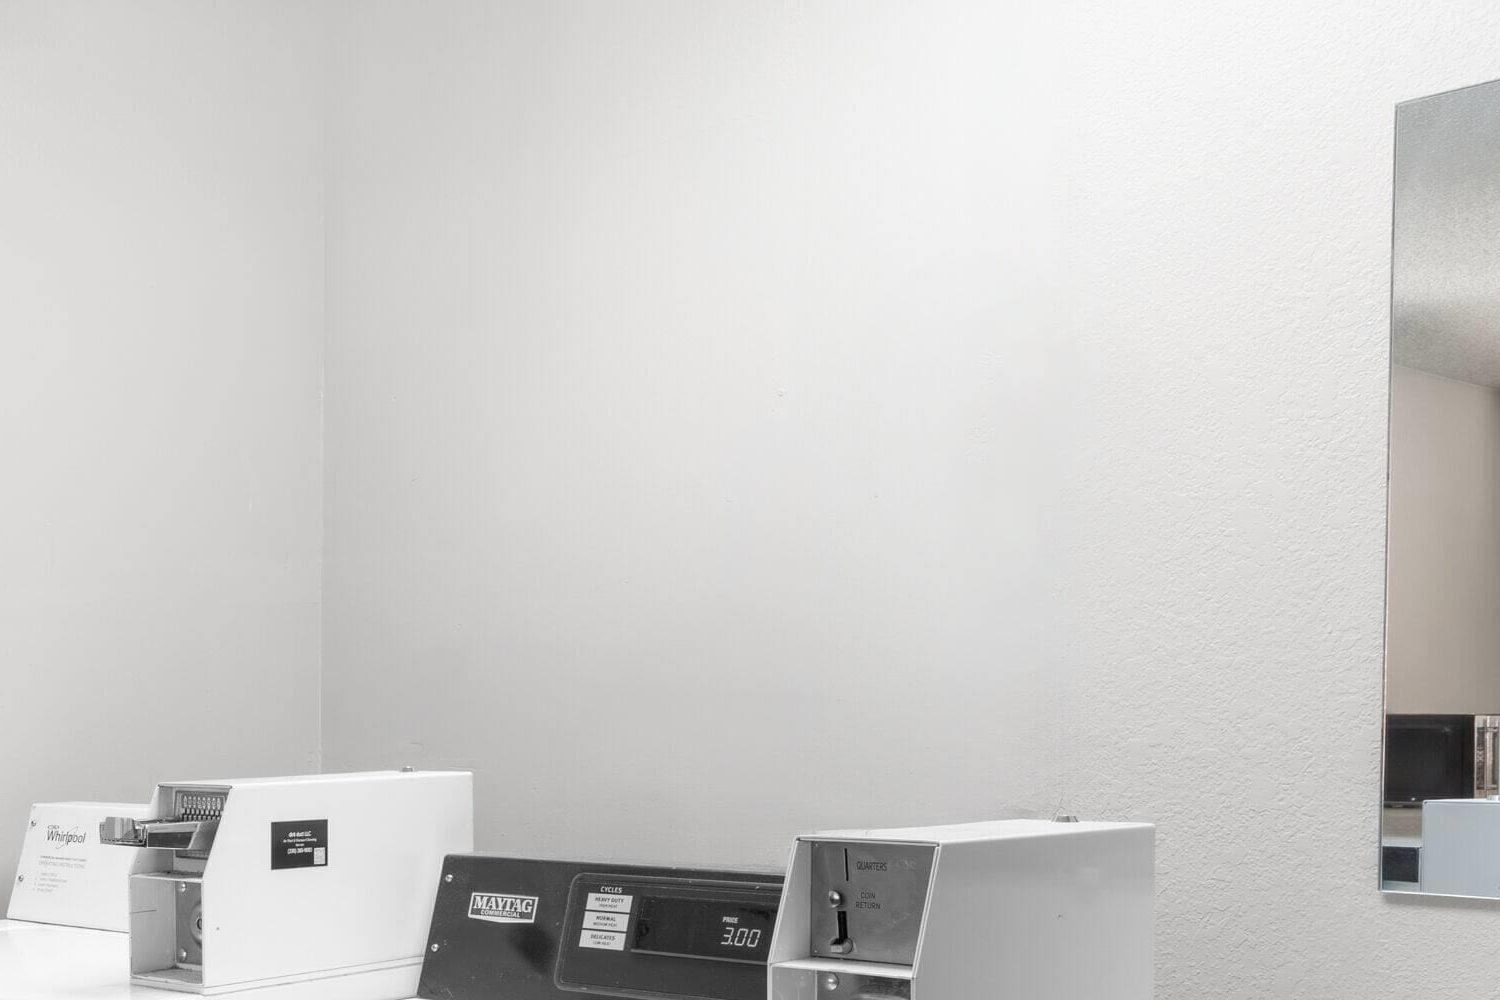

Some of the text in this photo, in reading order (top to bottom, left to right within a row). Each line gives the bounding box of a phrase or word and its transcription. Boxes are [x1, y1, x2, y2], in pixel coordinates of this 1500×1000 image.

[47, 830, 87, 845] Whirlpool
[856, 861, 887, 871] QUARTERS
[600, 886, 623, 894] CYCLES
[860, 891, 876, 899] COIN
[473, 895, 533, 913] MAYTAG
[855, 901, 881, 909] RETURN
[481, 909, 521, 918] COMMERCIAL
[722, 916, 739, 924] PRICE
[721, 927, 761, 947] 3.00
